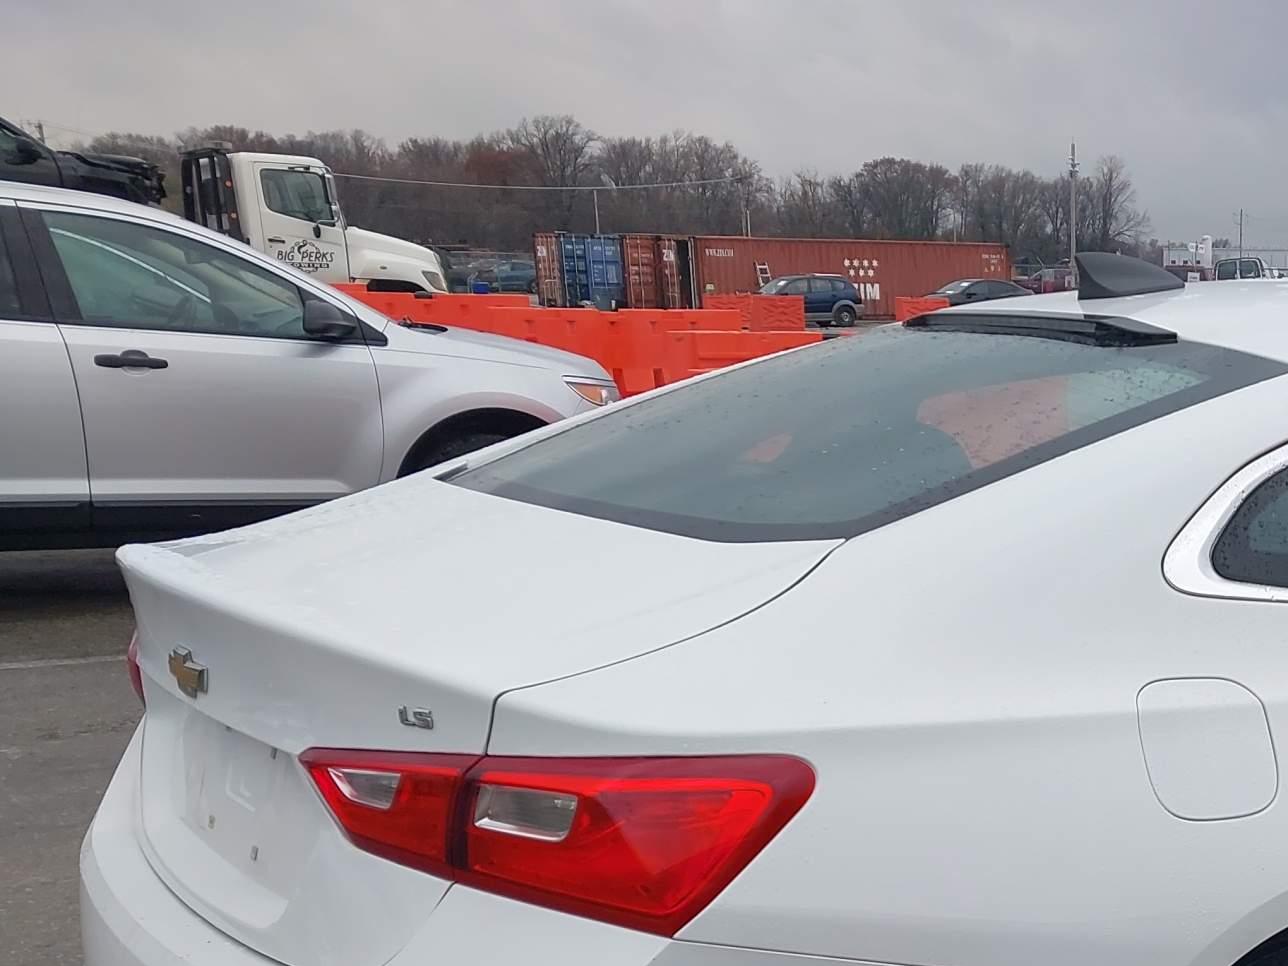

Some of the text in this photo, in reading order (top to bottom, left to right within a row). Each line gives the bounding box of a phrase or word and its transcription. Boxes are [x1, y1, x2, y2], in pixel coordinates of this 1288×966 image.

[277, 250, 335, 262] BIG PERKS
[852, 283, 881, 300] IM
[398, 705, 434, 730] LS
